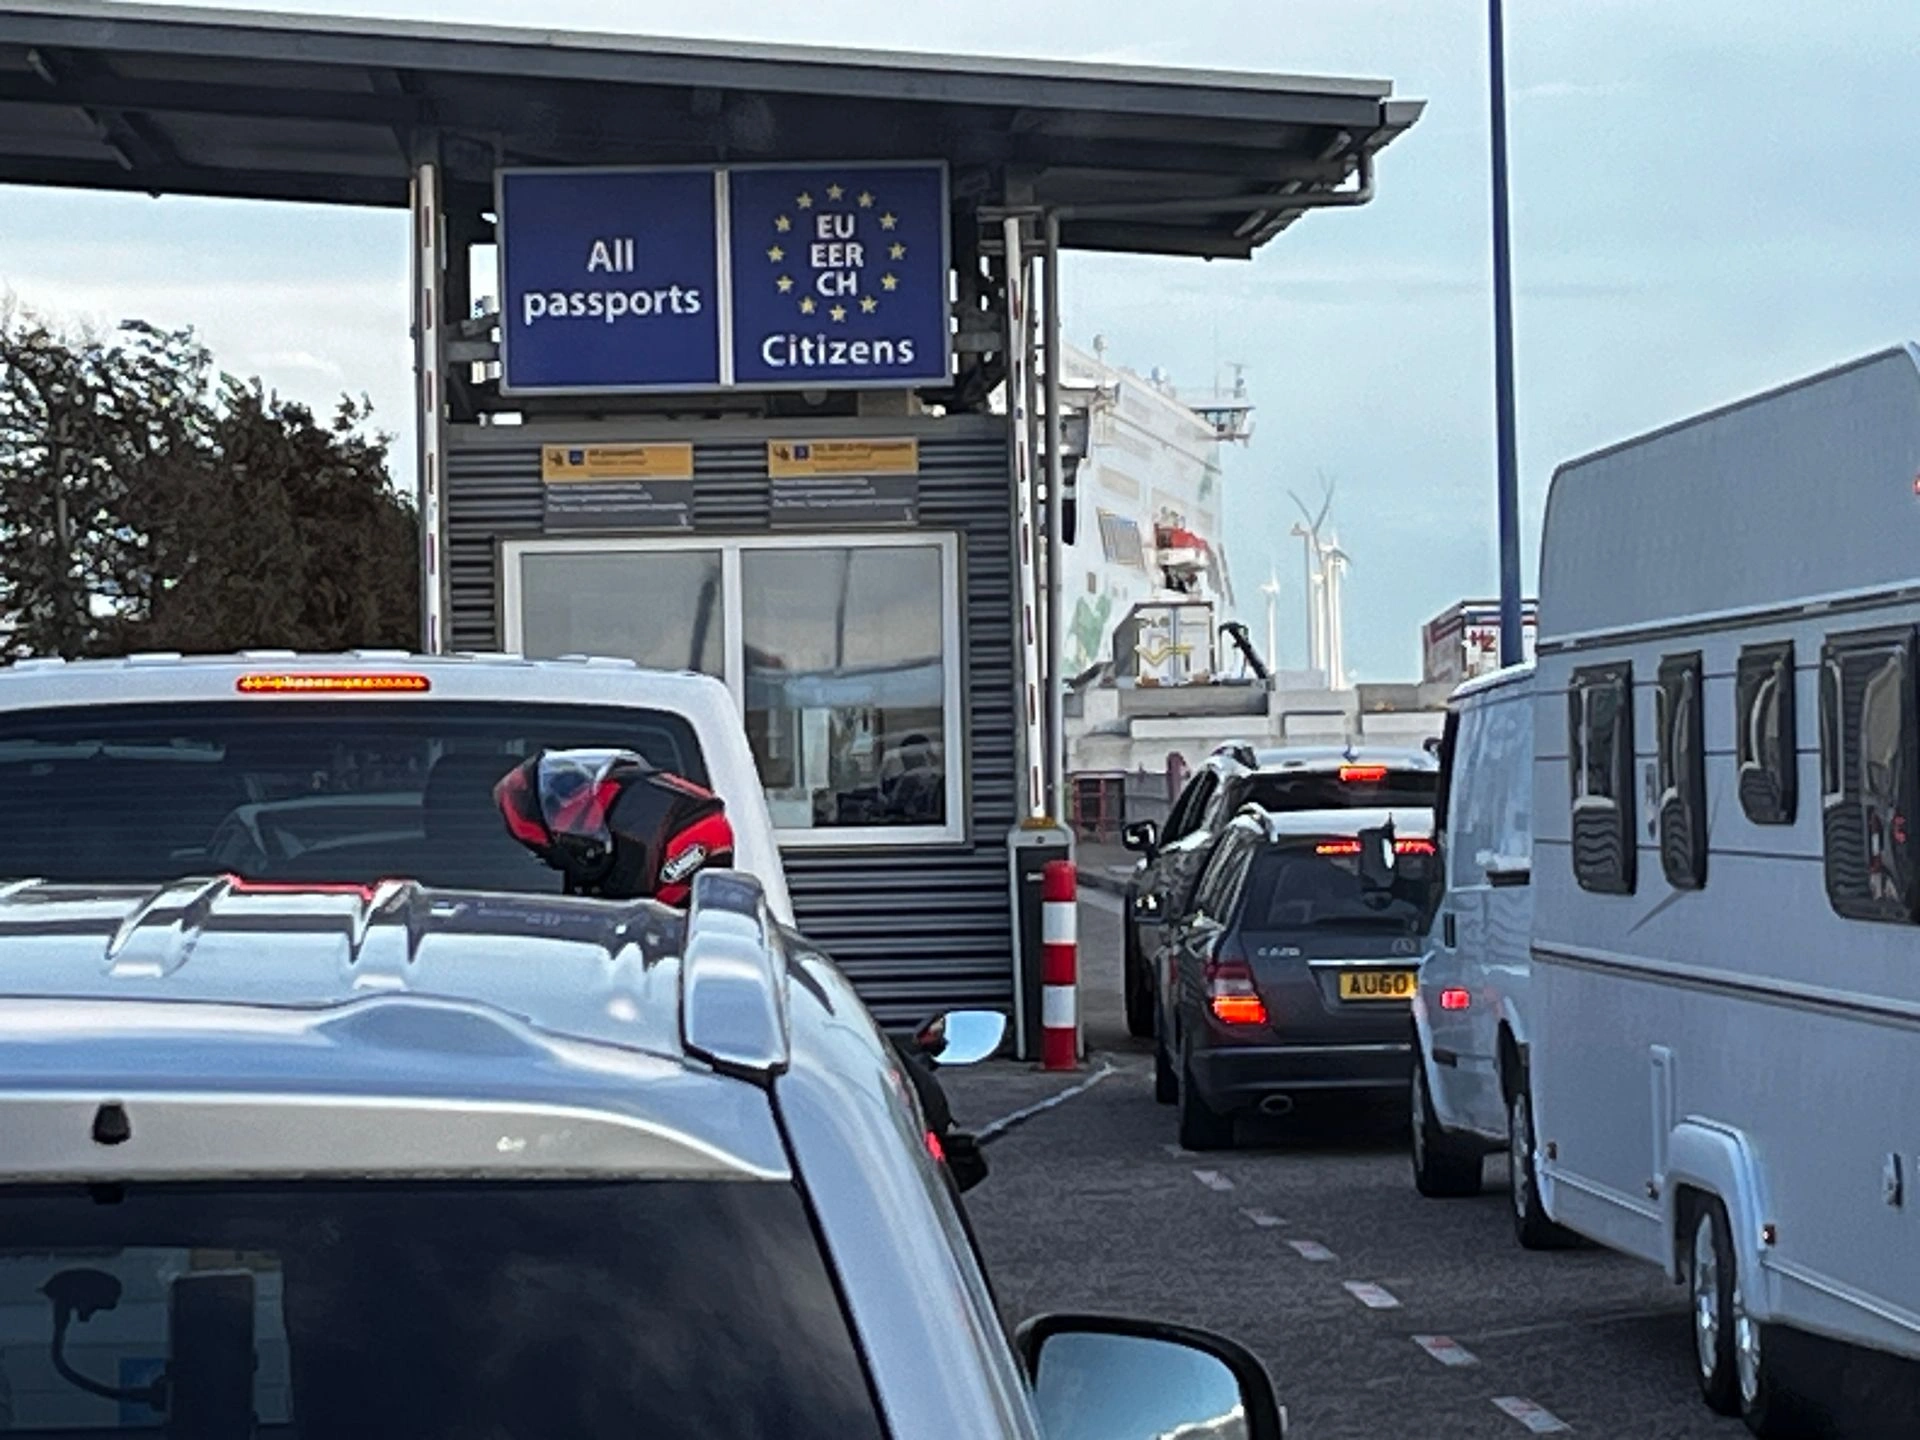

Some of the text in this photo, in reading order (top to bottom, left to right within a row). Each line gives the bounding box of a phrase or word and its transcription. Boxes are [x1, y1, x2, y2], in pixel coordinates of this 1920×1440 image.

[817, 215, 854, 239] EU
[587, 239, 634, 272] All
[811, 243, 864, 268] EER
[816, 271, 857, 297] CH
[524, 285, 701, 325] passports
[762, 334, 914, 366] Citizens
[1349, 973, 1408, 994] AU60
